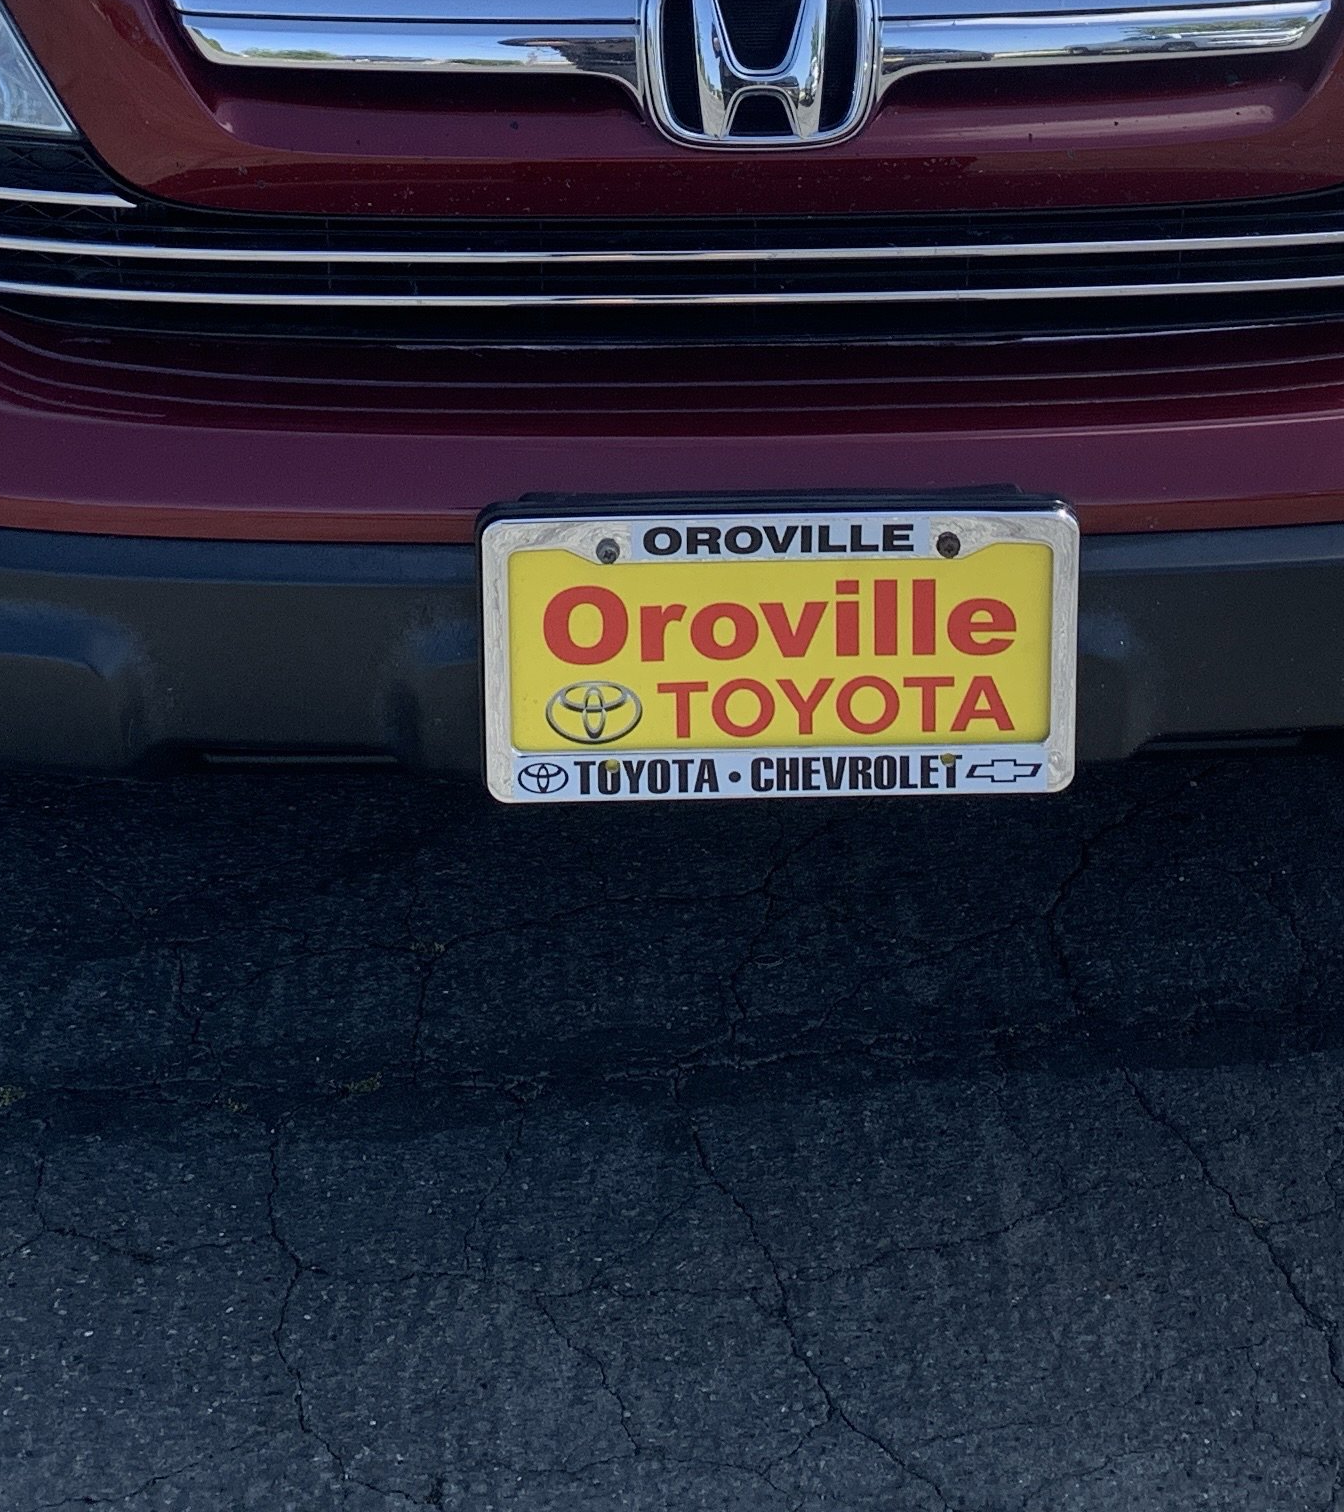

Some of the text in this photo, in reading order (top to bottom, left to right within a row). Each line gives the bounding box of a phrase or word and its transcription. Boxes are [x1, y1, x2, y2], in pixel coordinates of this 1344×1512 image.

[642, 522, 916, 557] OROVILLE
[542, 577, 1017, 666] Oroville
[656, 674, 1016, 739] TOYOTA
[573, 753, 964, 796] TOYOTA CHEVROLET
